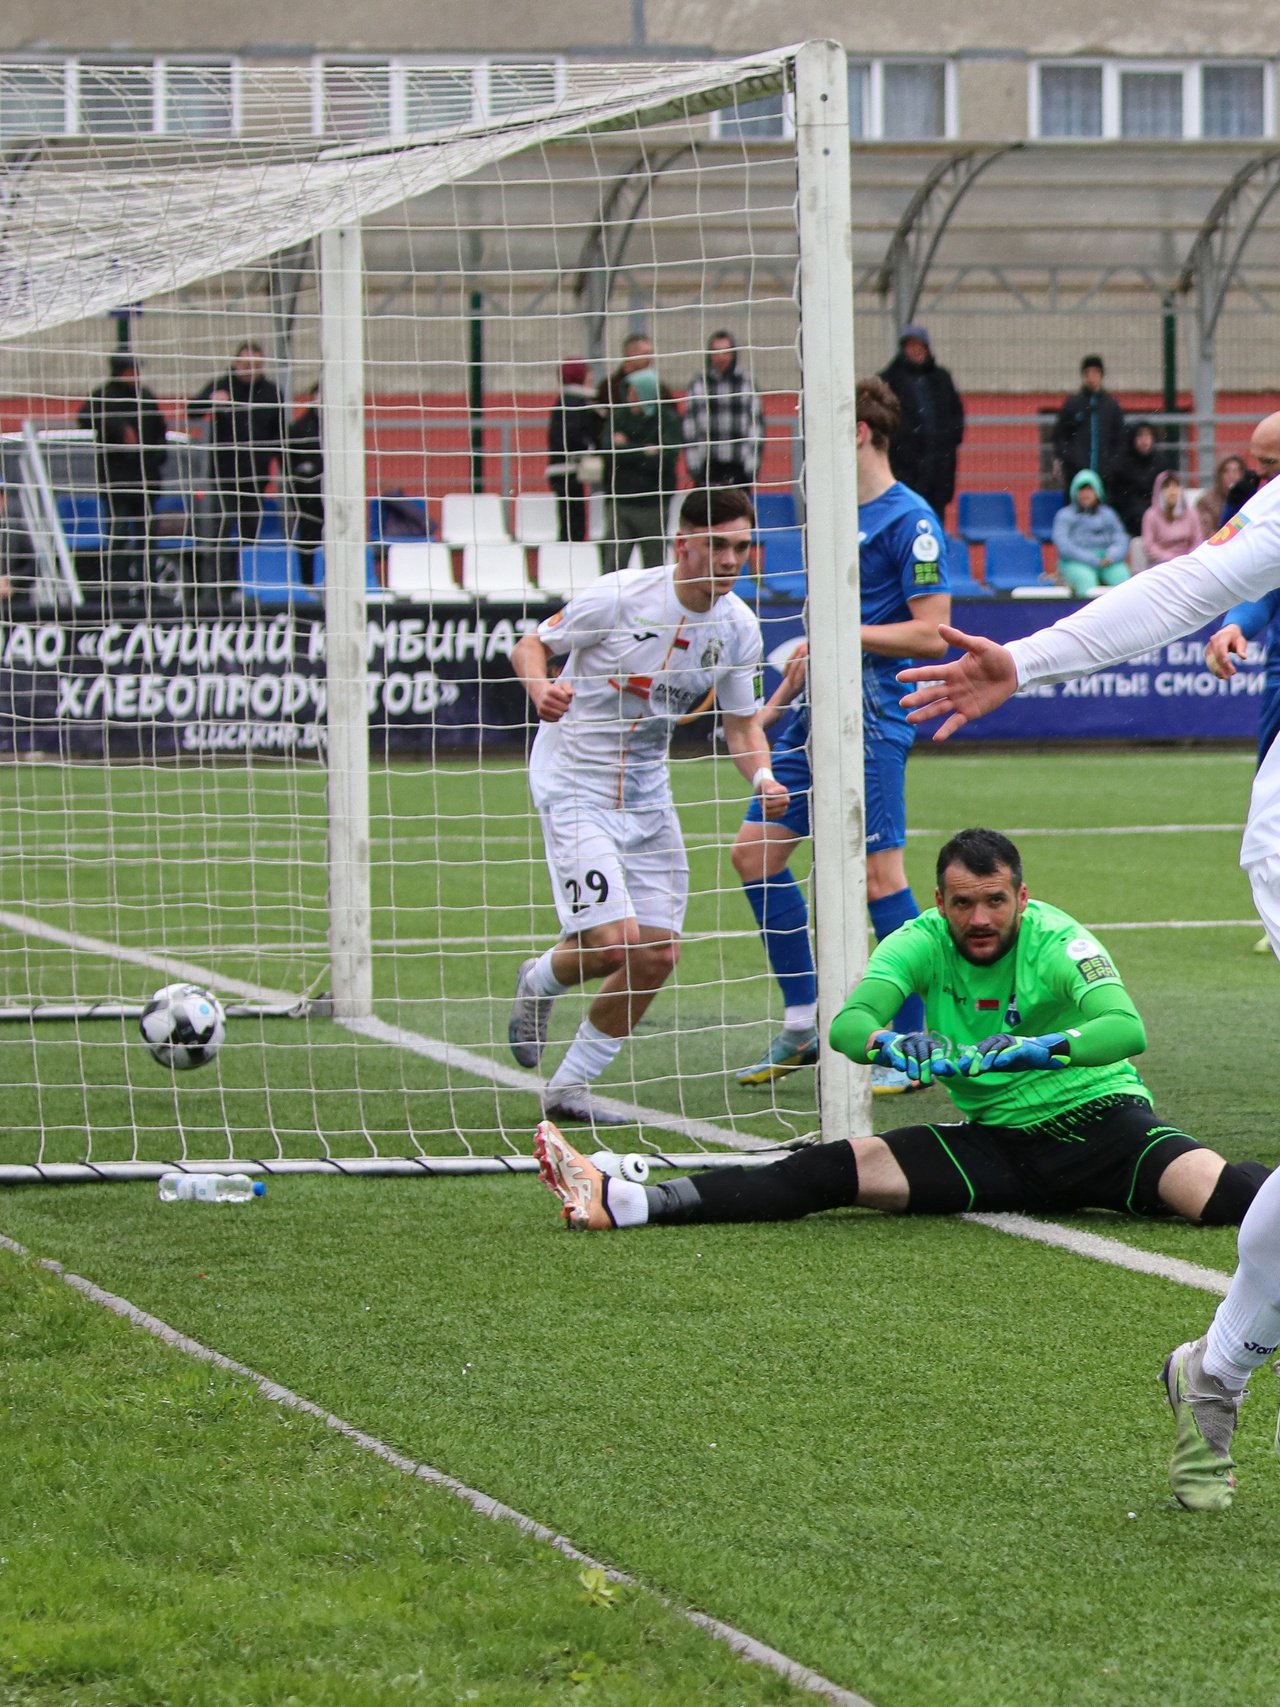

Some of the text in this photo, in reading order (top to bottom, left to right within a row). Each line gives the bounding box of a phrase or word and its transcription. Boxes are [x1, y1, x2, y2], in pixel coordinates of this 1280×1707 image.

[0, 622, 66, 667] АО
[307, 618, 539, 663] КМБИНАТ
[56, 670, 460, 717] ХЛЕБОПРОДУТОВ»
[564, 869, 609, 914] 29
